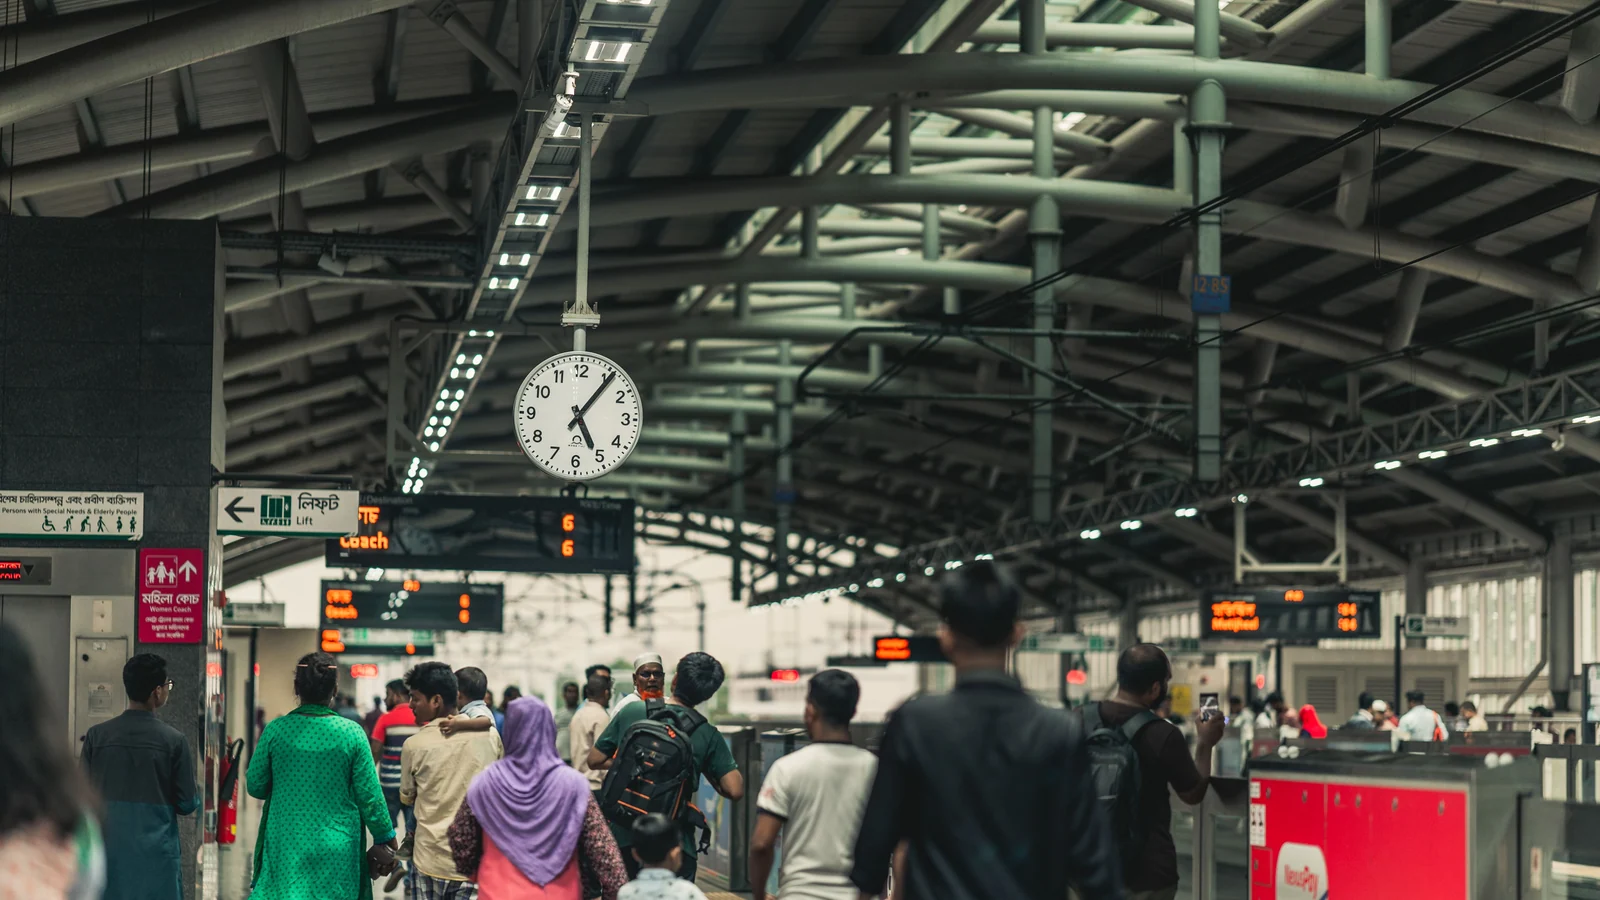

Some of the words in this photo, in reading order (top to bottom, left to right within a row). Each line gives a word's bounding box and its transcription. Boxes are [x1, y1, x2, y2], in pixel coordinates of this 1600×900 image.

[553, 370, 564, 384] 11
[574, 364, 589, 378] 12
[535, 385, 551, 399] 10
[615, 390, 625, 404] 2
[526, 406, 536, 420] 9
[620, 412, 631, 426] 3
[532, 429, 543, 443] 8
[611, 435, 621, 448] 4
[550, 446, 560, 460] 7
[595, 449, 605, 463] 5
[571, 455, 581, 468] 6
[65, 495, 82, 505] এবং
[84, 494, 105, 505] প্রবীণ
[42, 507, 65, 515] Special
[93, 508, 114, 516] Elderly
[116, 508, 137, 516] People
[296, 516, 313, 525] Lift
[562, 513, 575, 532] 6
[340, 531, 389, 549] Coach
[562, 539, 575, 557] 6
[142, 590, 174, 605] মহিলা
[176, 593, 200, 604] কোচ
